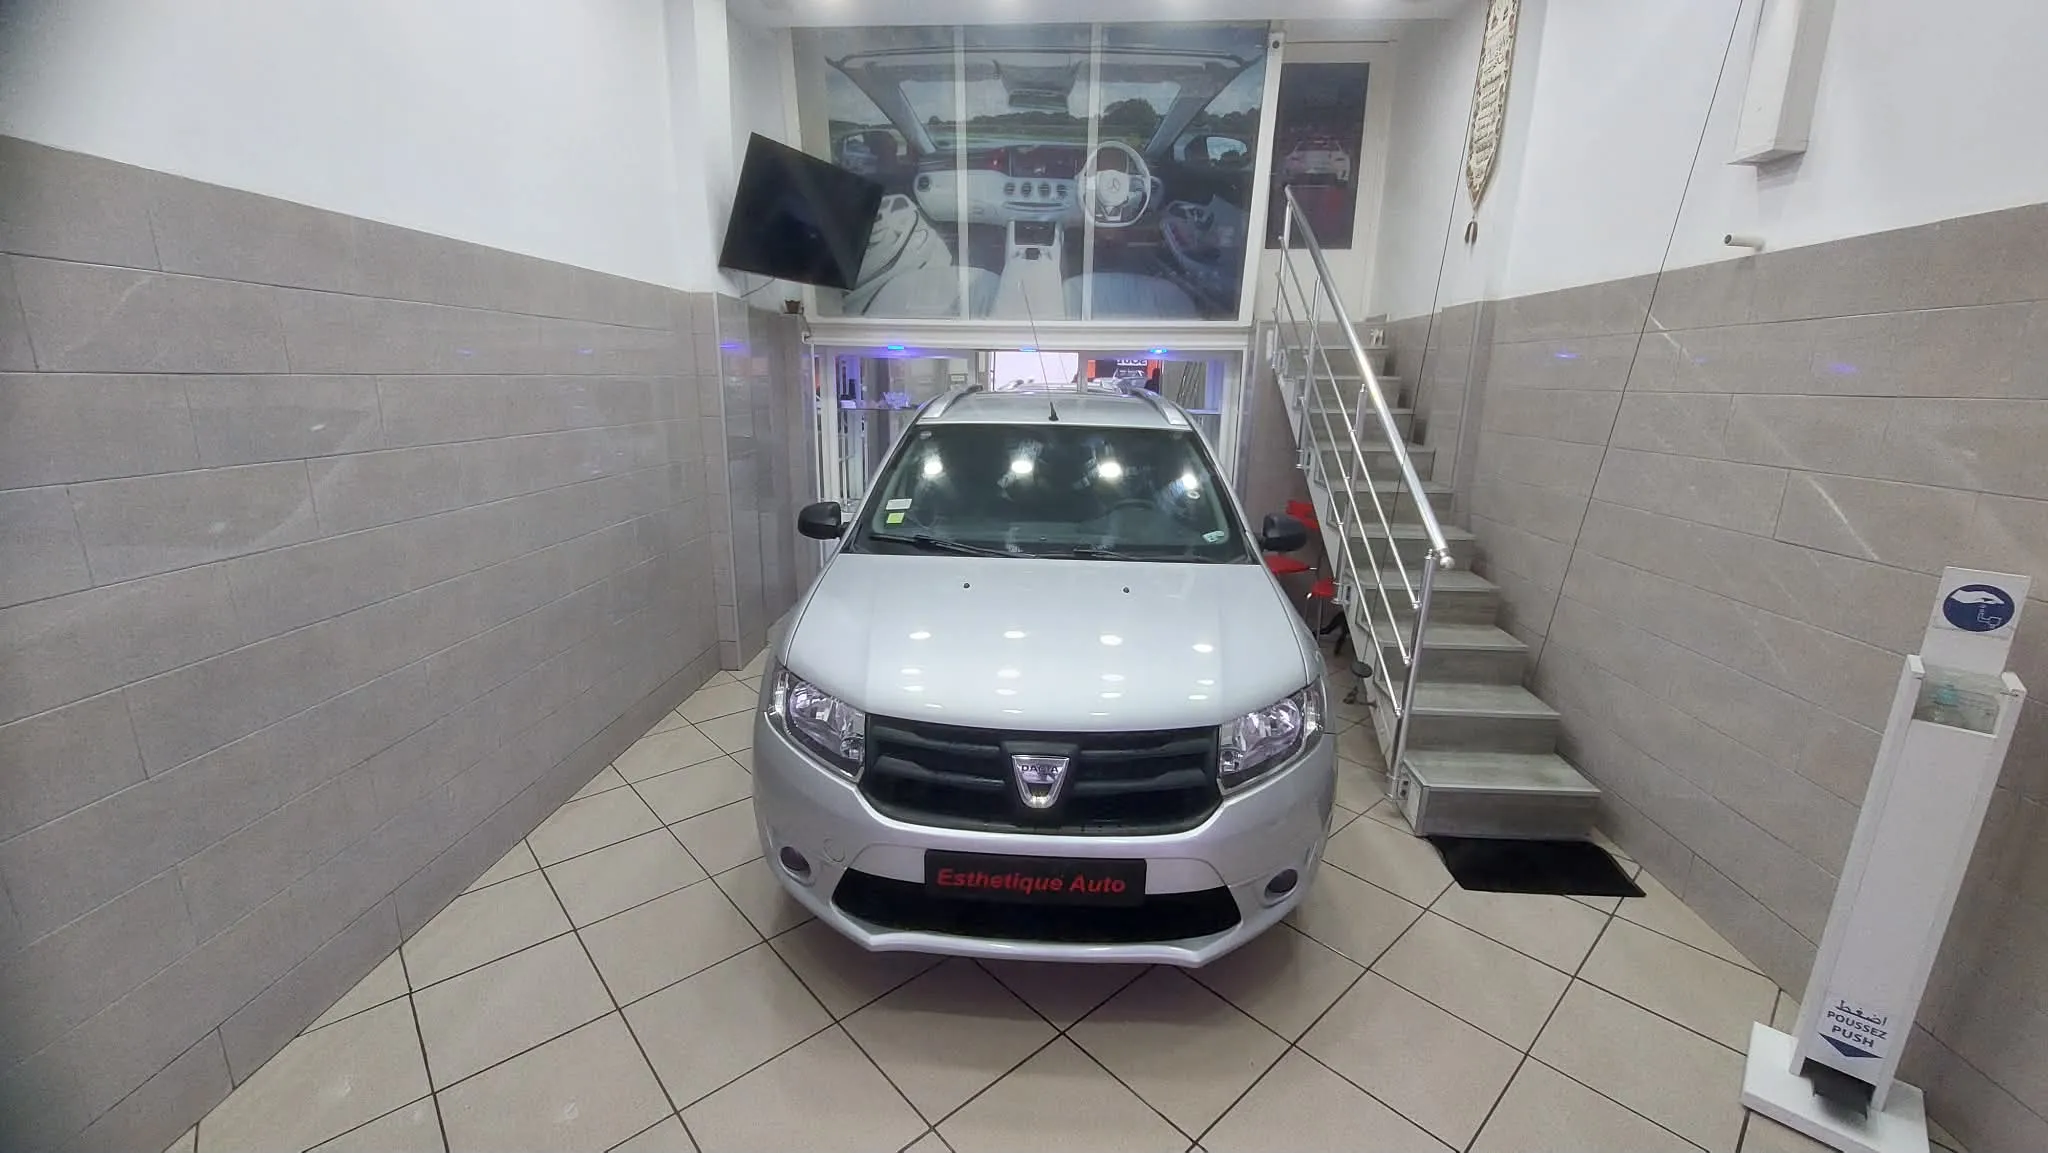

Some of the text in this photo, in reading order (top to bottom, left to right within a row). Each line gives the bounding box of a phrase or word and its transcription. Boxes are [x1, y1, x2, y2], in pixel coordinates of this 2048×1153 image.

[936, 867, 1126, 894] Esthetique Auto
[1827, 1010, 1888, 1040] POUSSEZ
[1834, 1000, 1887, 1026] اضغط
[1832, 1025, 1875, 1047] PUSH
